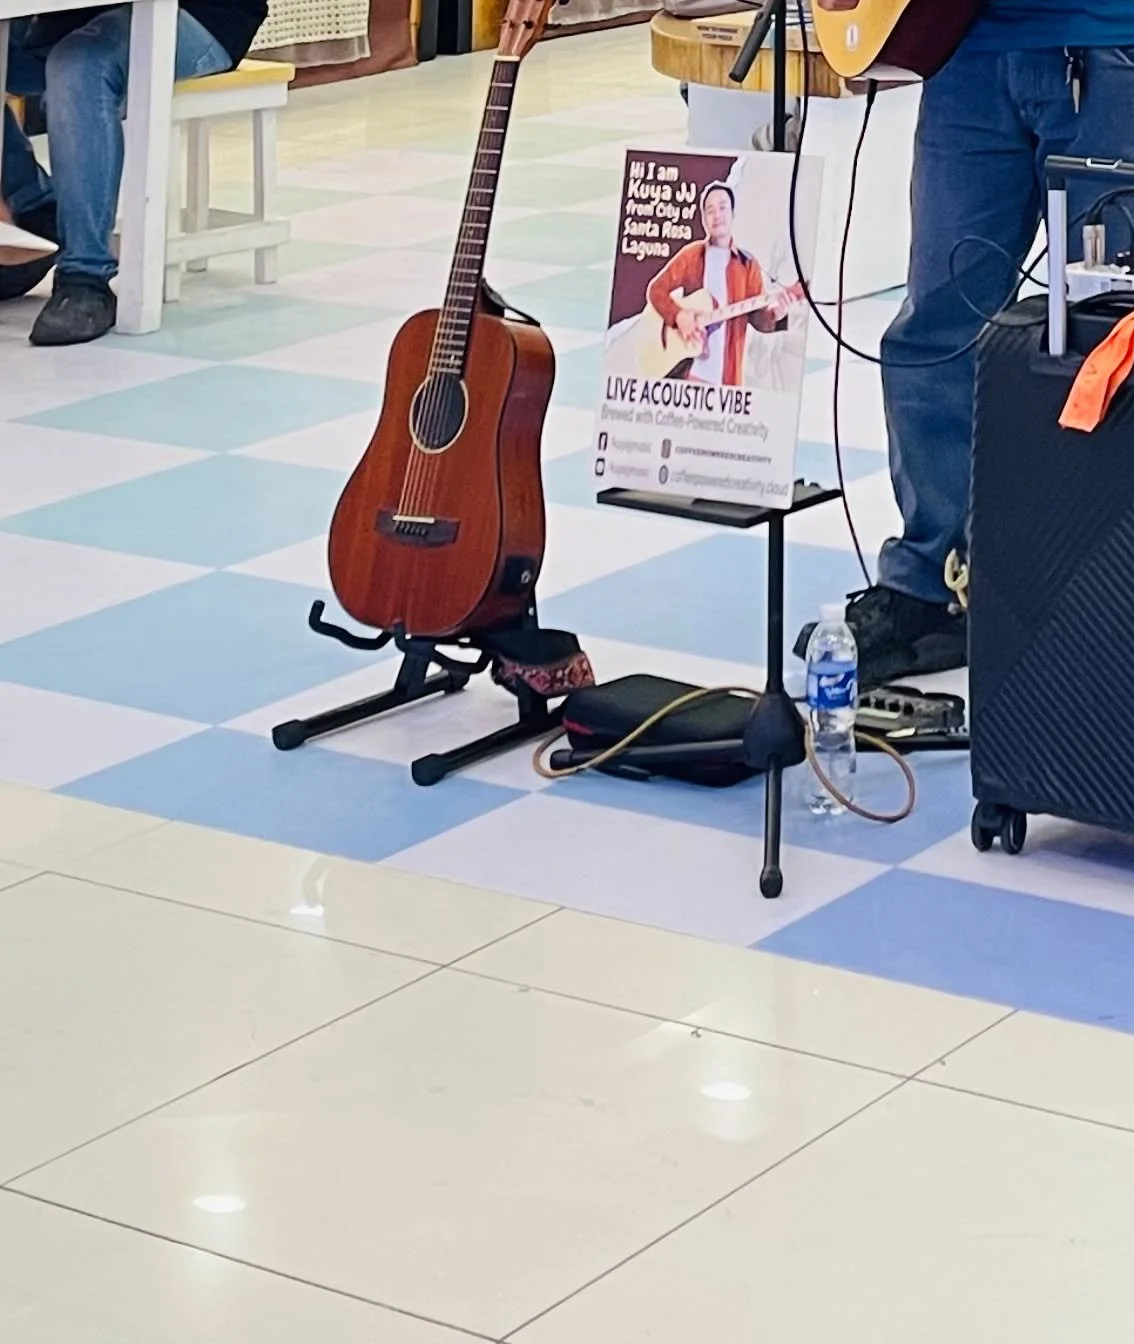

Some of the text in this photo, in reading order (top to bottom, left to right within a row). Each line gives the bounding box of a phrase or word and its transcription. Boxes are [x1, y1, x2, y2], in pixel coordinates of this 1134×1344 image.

[629, 160, 679, 181] Hi I am
[627, 178, 697, 208] Kuya JJ
[625, 198, 697, 224] from City of
[622, 216, 692, 241] Santa Rosa
[621, 236, 670, 262] Laguna
[606, 375, 753, 416] LIVE ACOUSTIC VIBE
